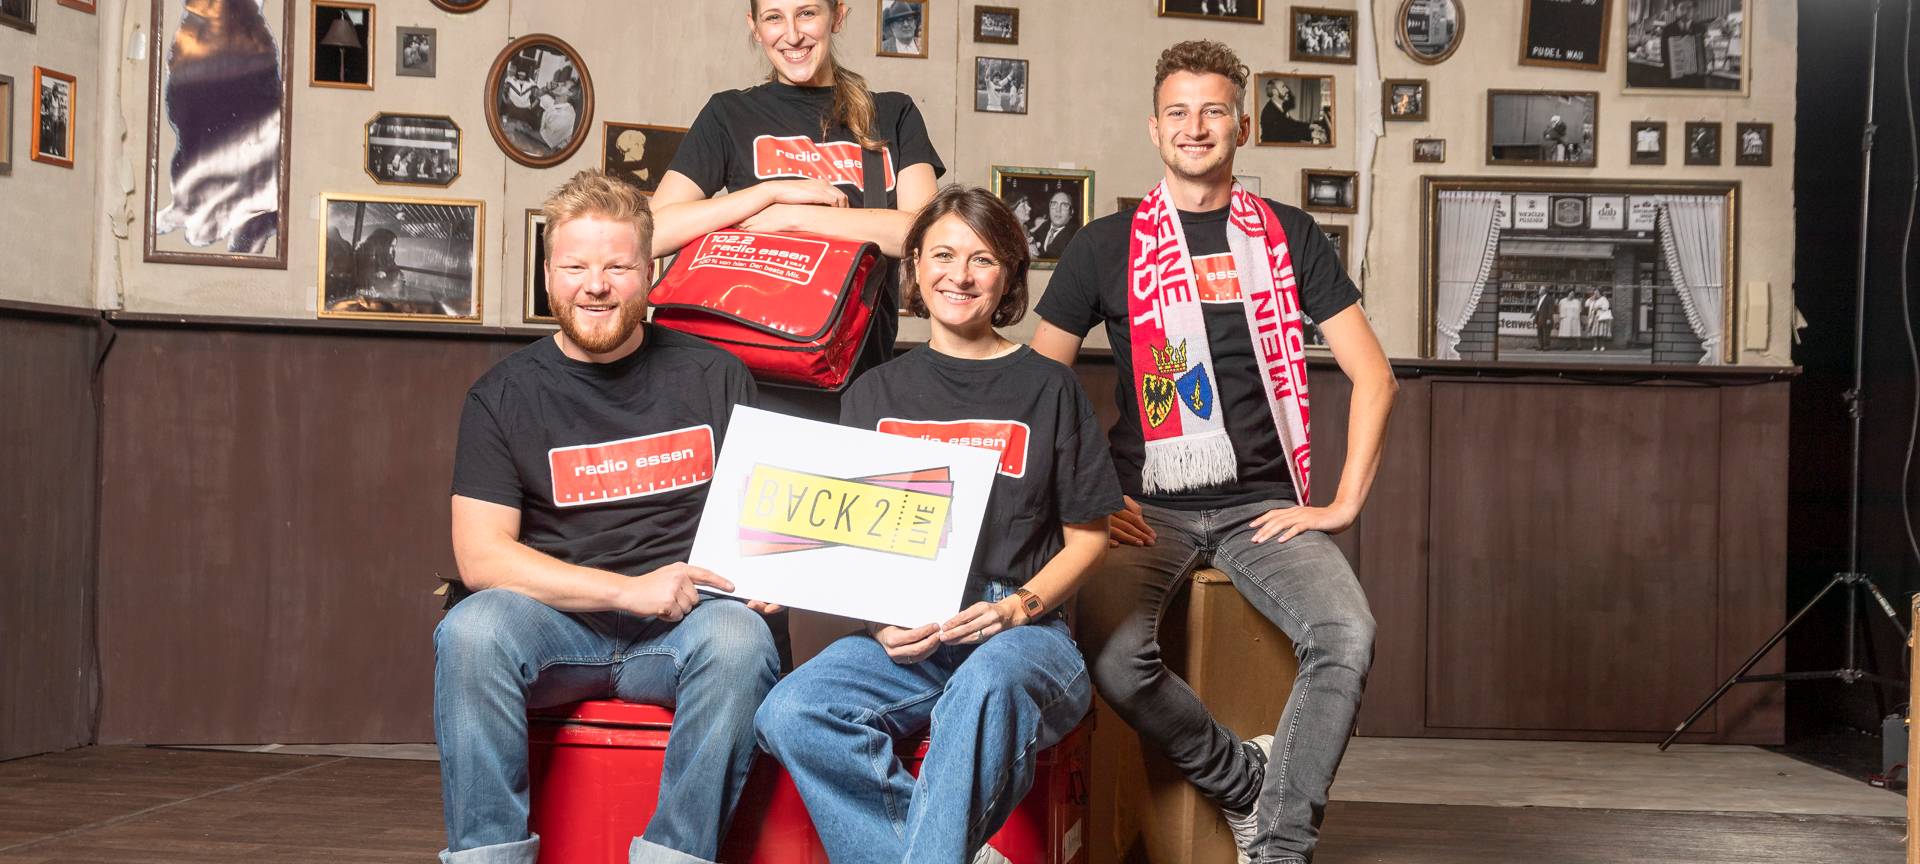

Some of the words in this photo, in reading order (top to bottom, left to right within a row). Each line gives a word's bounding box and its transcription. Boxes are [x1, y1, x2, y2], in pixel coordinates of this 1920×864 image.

[1531, 46, 1562, 58] PUDEL
[775, 149, 821, 162] radio
[711, 235, 756, 245] 102.2
[711, 244, 757, 254] radio
[758, 247, 811, 263] essen
[764, 265, 785, 275] beste
[1206, 270, 1237, 281] ess
[1251, 290, 1292, 400] MEIN
[948, 437, 1006, 449] essen
[574, 459, 628, 477] radio
[635, 448, 694, 468] essen
[756, 479, 861, 533] BACK
[866, 498, 891, 537] 2
[908, 503, 936, 545] LIVE
